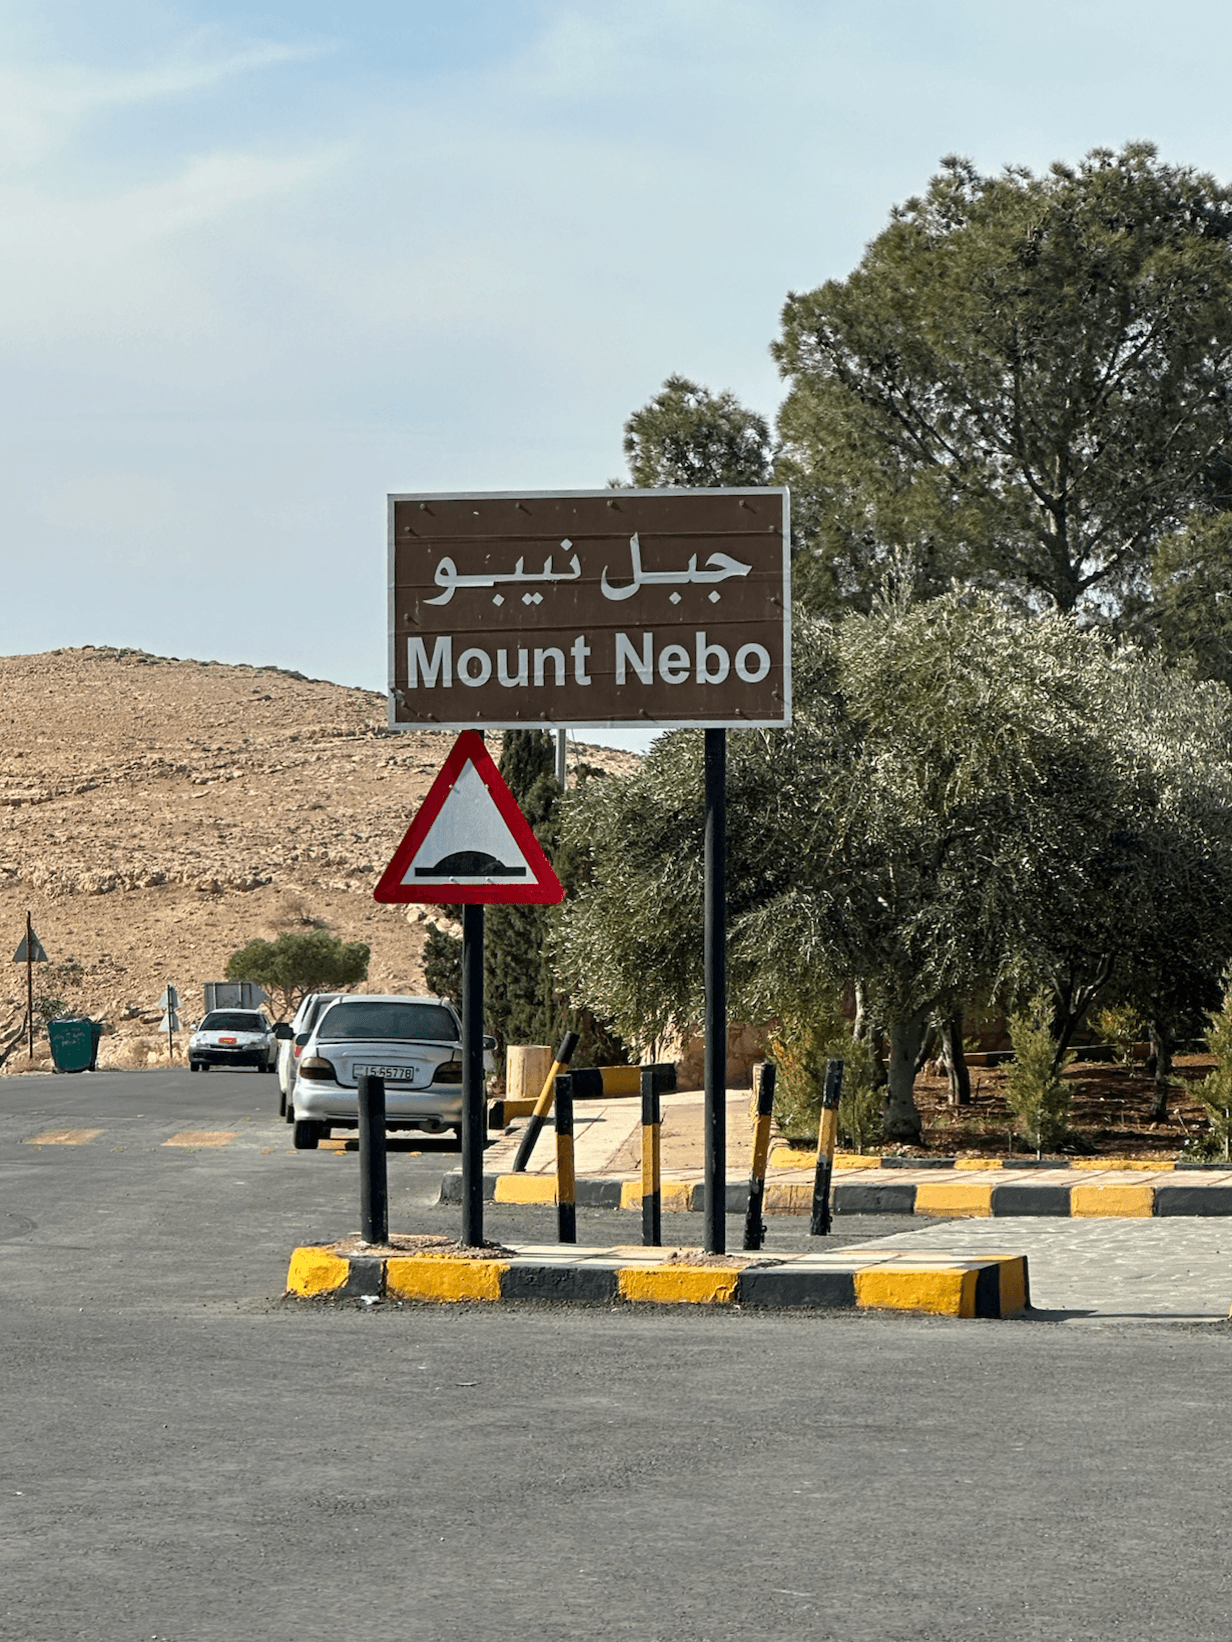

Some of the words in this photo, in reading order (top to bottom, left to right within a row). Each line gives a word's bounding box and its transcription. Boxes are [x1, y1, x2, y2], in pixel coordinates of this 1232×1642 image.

[423, 538, 582, 606] نيبو
[600, 532, 753, 604] جبل
[407, 635, 592, 688] Mount
[615, 631, 771, 685] Nebo
